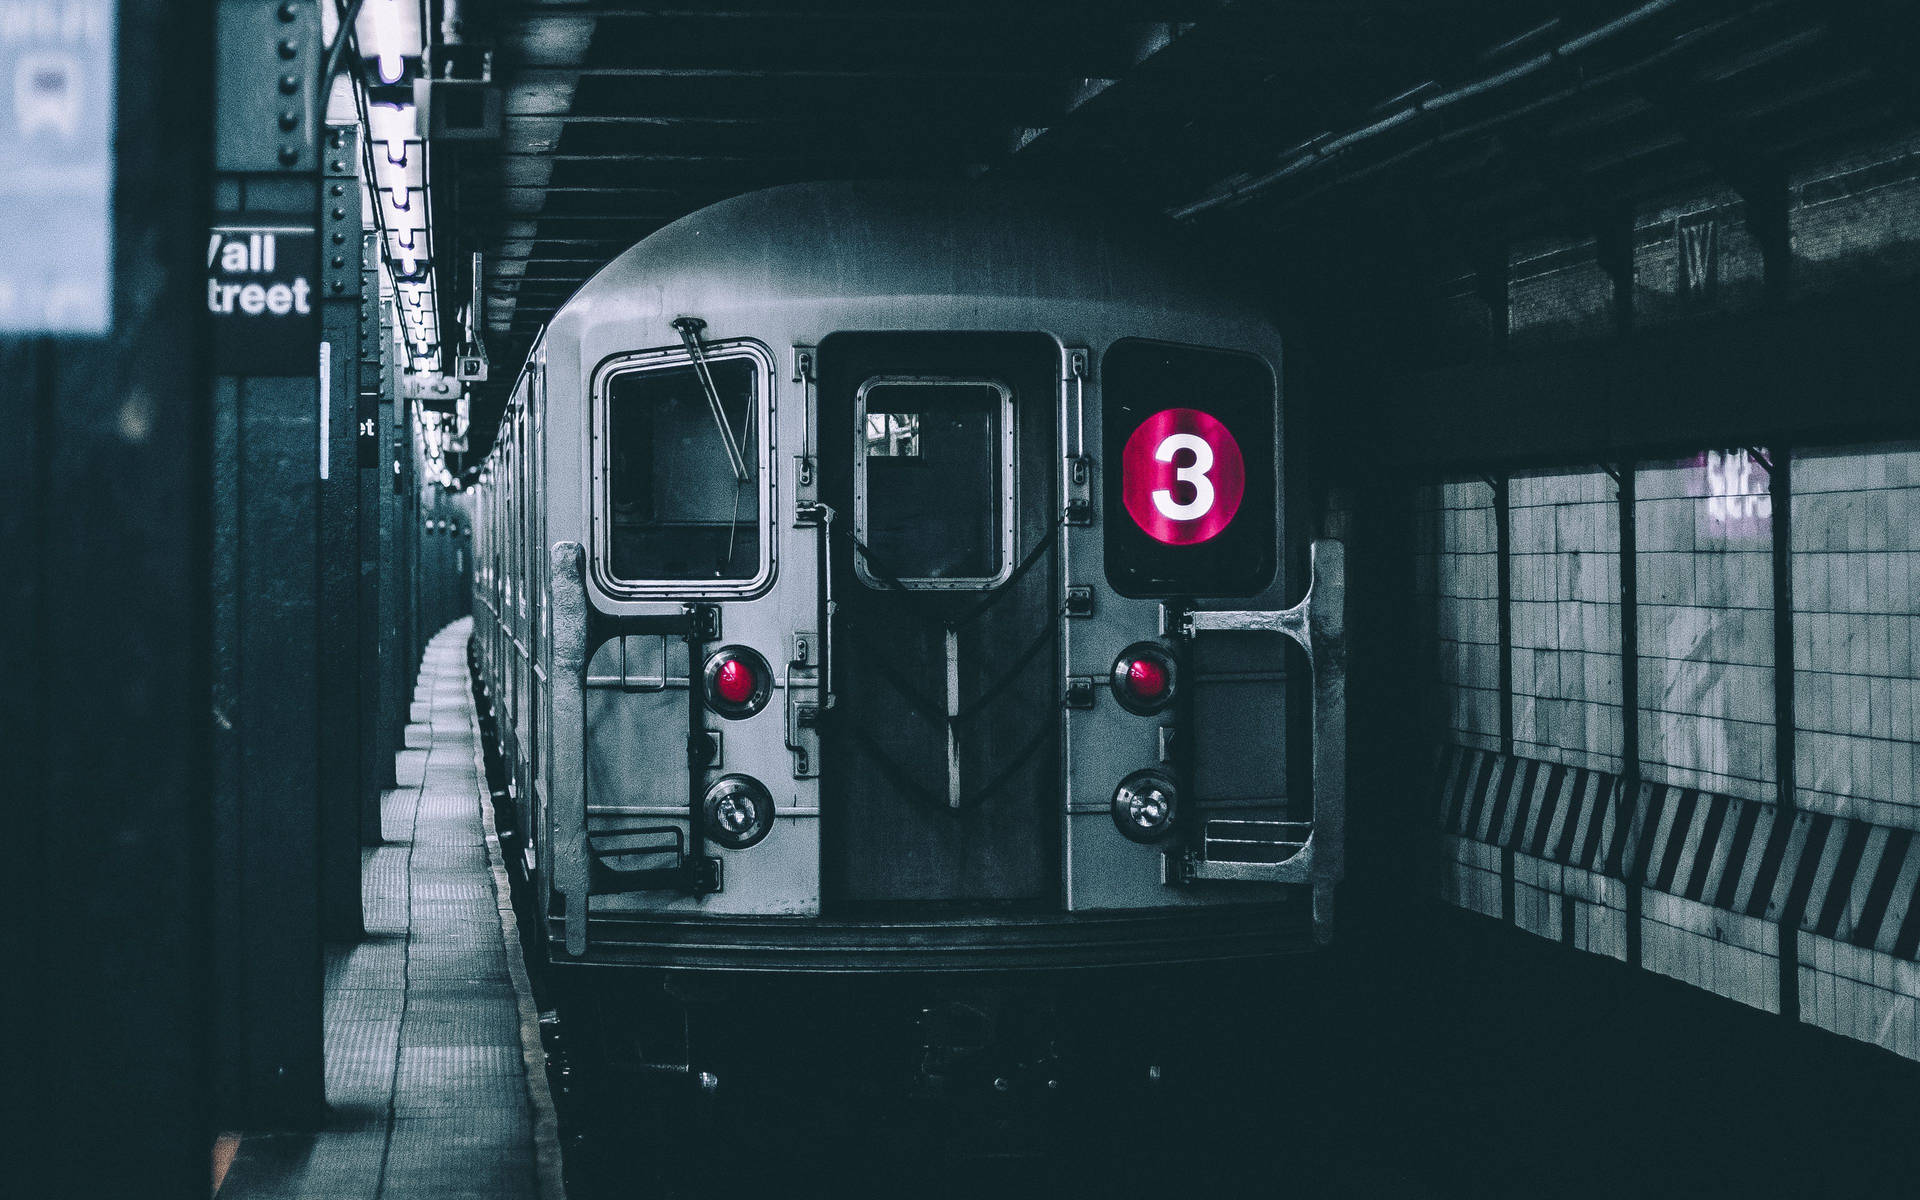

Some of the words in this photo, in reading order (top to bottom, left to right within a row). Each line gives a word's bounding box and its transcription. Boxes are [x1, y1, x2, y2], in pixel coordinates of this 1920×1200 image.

[1682, 221, 1714, 288] W
[207, 277, 311, 314] treet
[1152, 433, 1215, 521] 3
